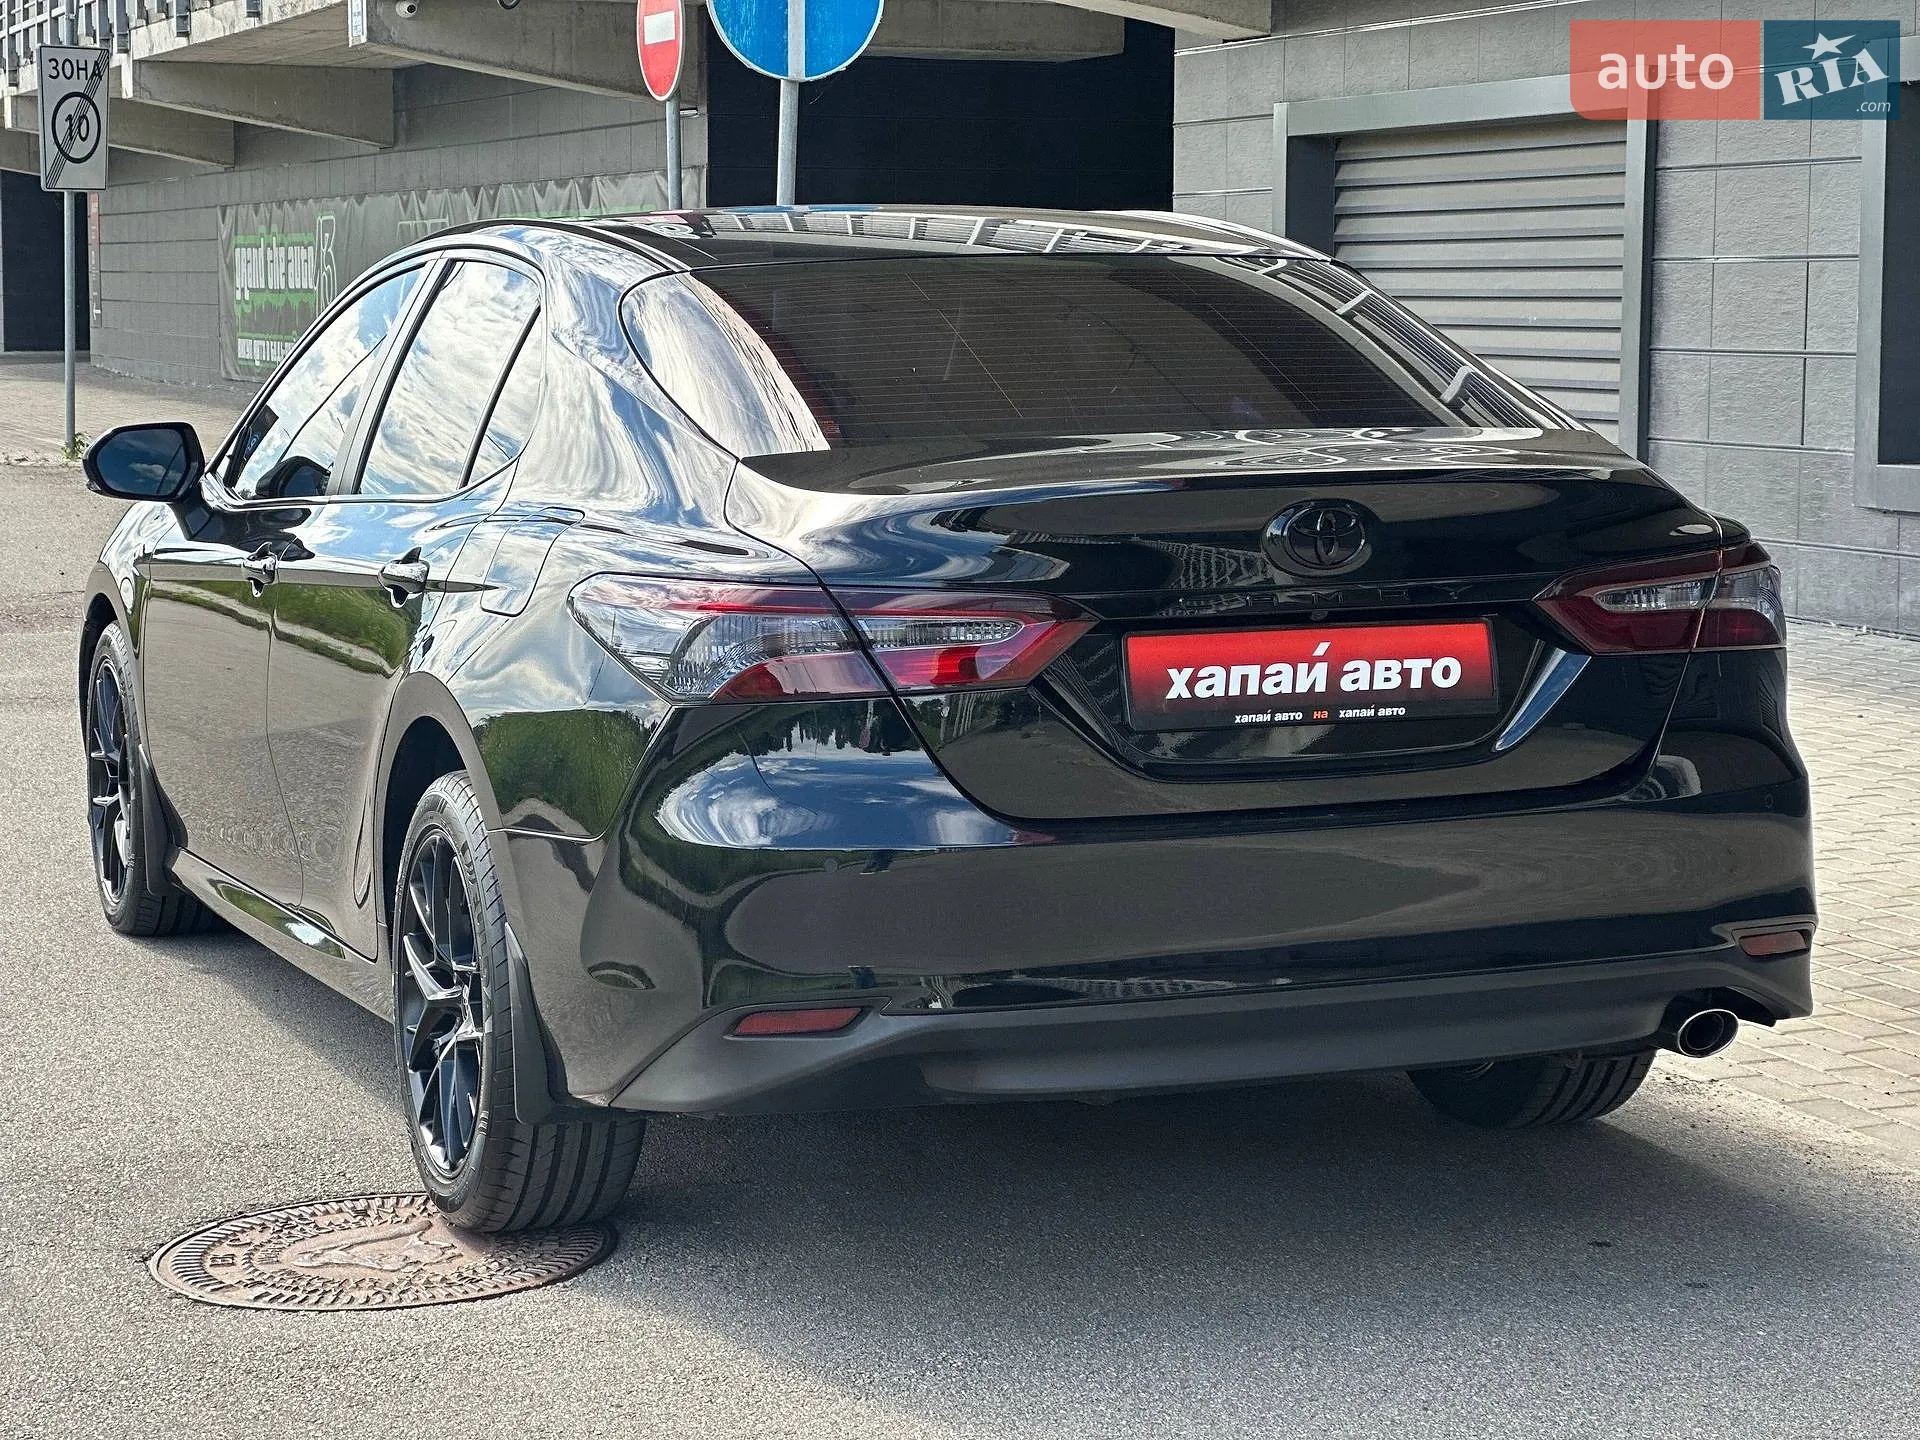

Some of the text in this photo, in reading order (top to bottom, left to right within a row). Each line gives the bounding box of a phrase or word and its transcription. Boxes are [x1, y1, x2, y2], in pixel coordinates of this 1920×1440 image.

[65, 113, 90, 142] 10
[1340, 656, 1463, 692] авто
[1274, 710, 1303, 722] авто
[1313, 709, 1329, 721] на
[1377, 706, 1406, 718] авто
